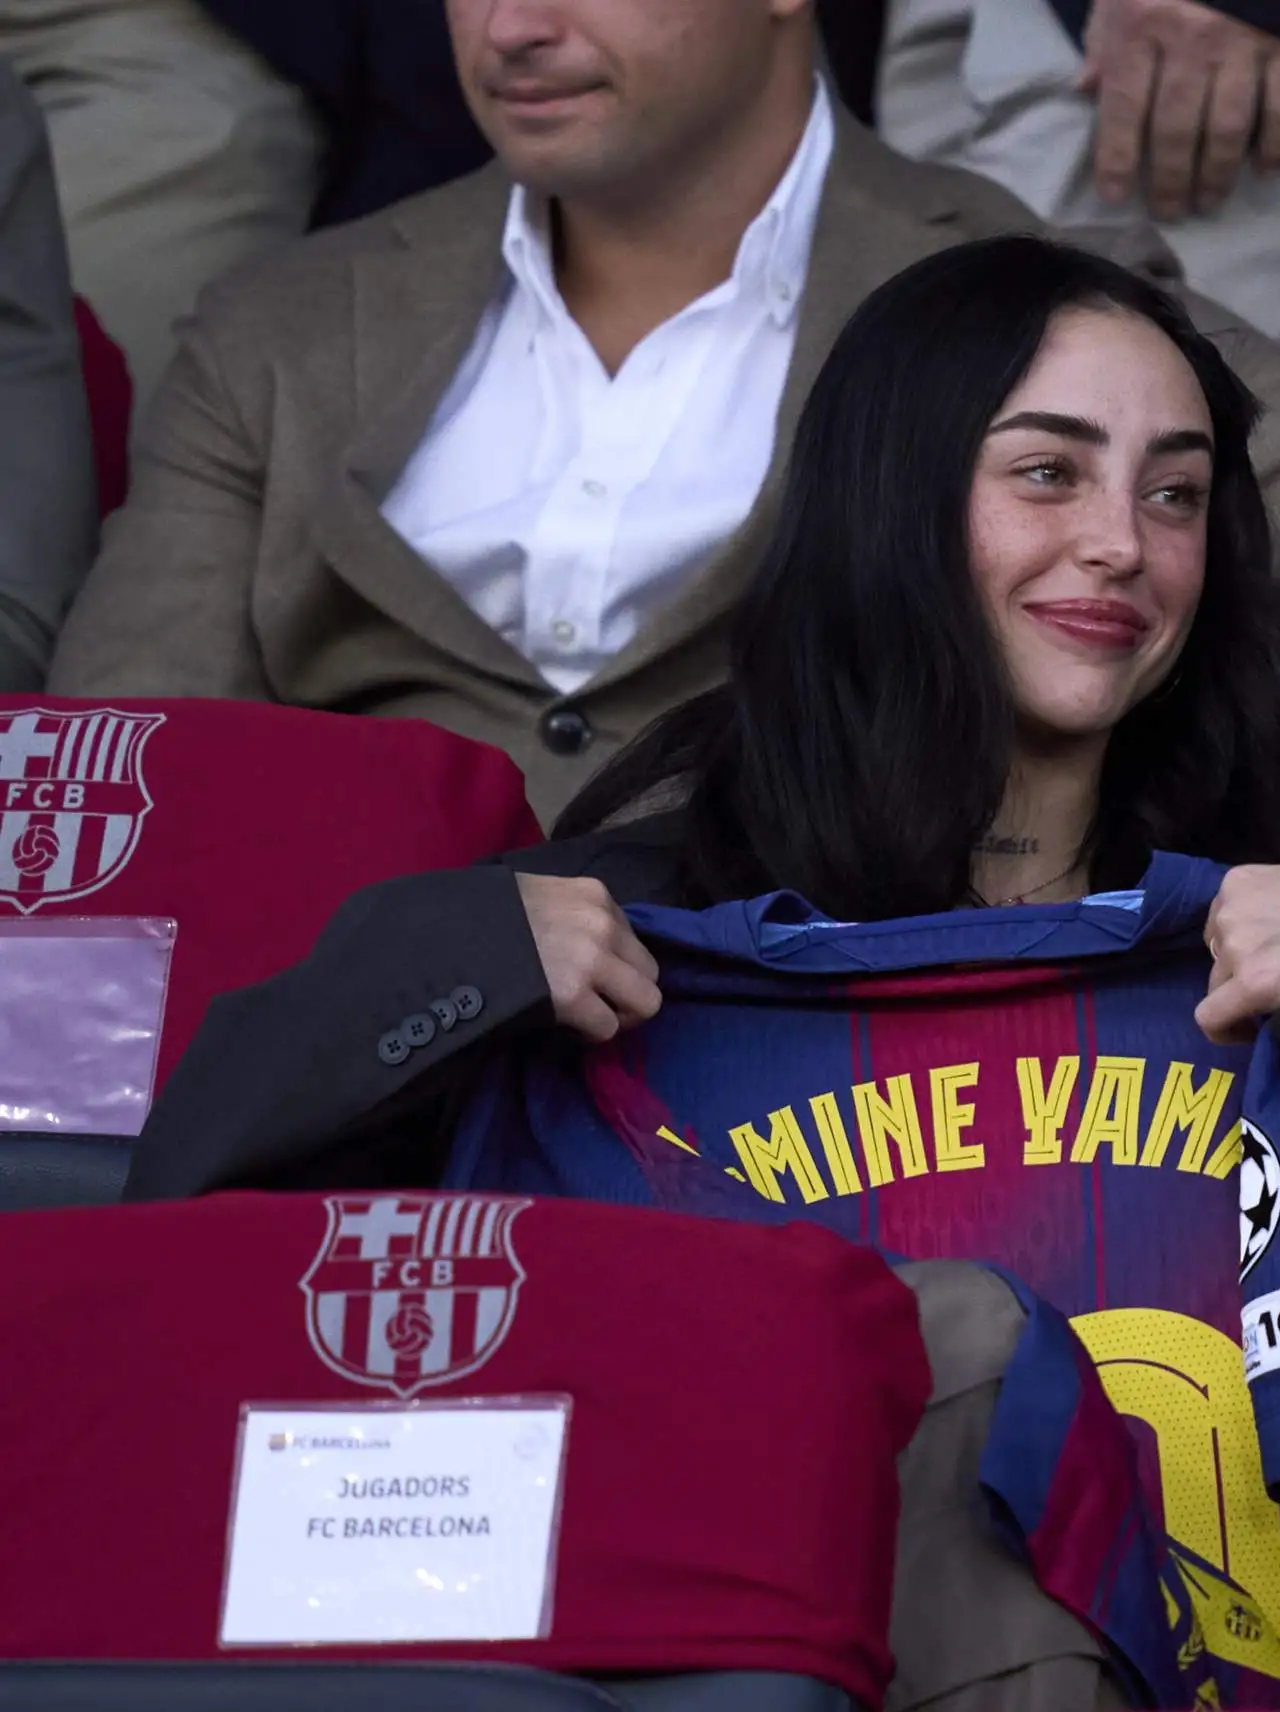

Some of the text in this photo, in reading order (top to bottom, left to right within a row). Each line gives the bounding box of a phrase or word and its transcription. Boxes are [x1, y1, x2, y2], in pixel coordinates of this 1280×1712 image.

[7, 782, 85, 809] FCB
[656, 1055, 1245, 1205] MINE YAM
[372, 1260, 454, 1288] FCB
[338, 1476, 470, 1499] JUGADORS
[307, 1515, 491, 1539] FC BARCELONA
